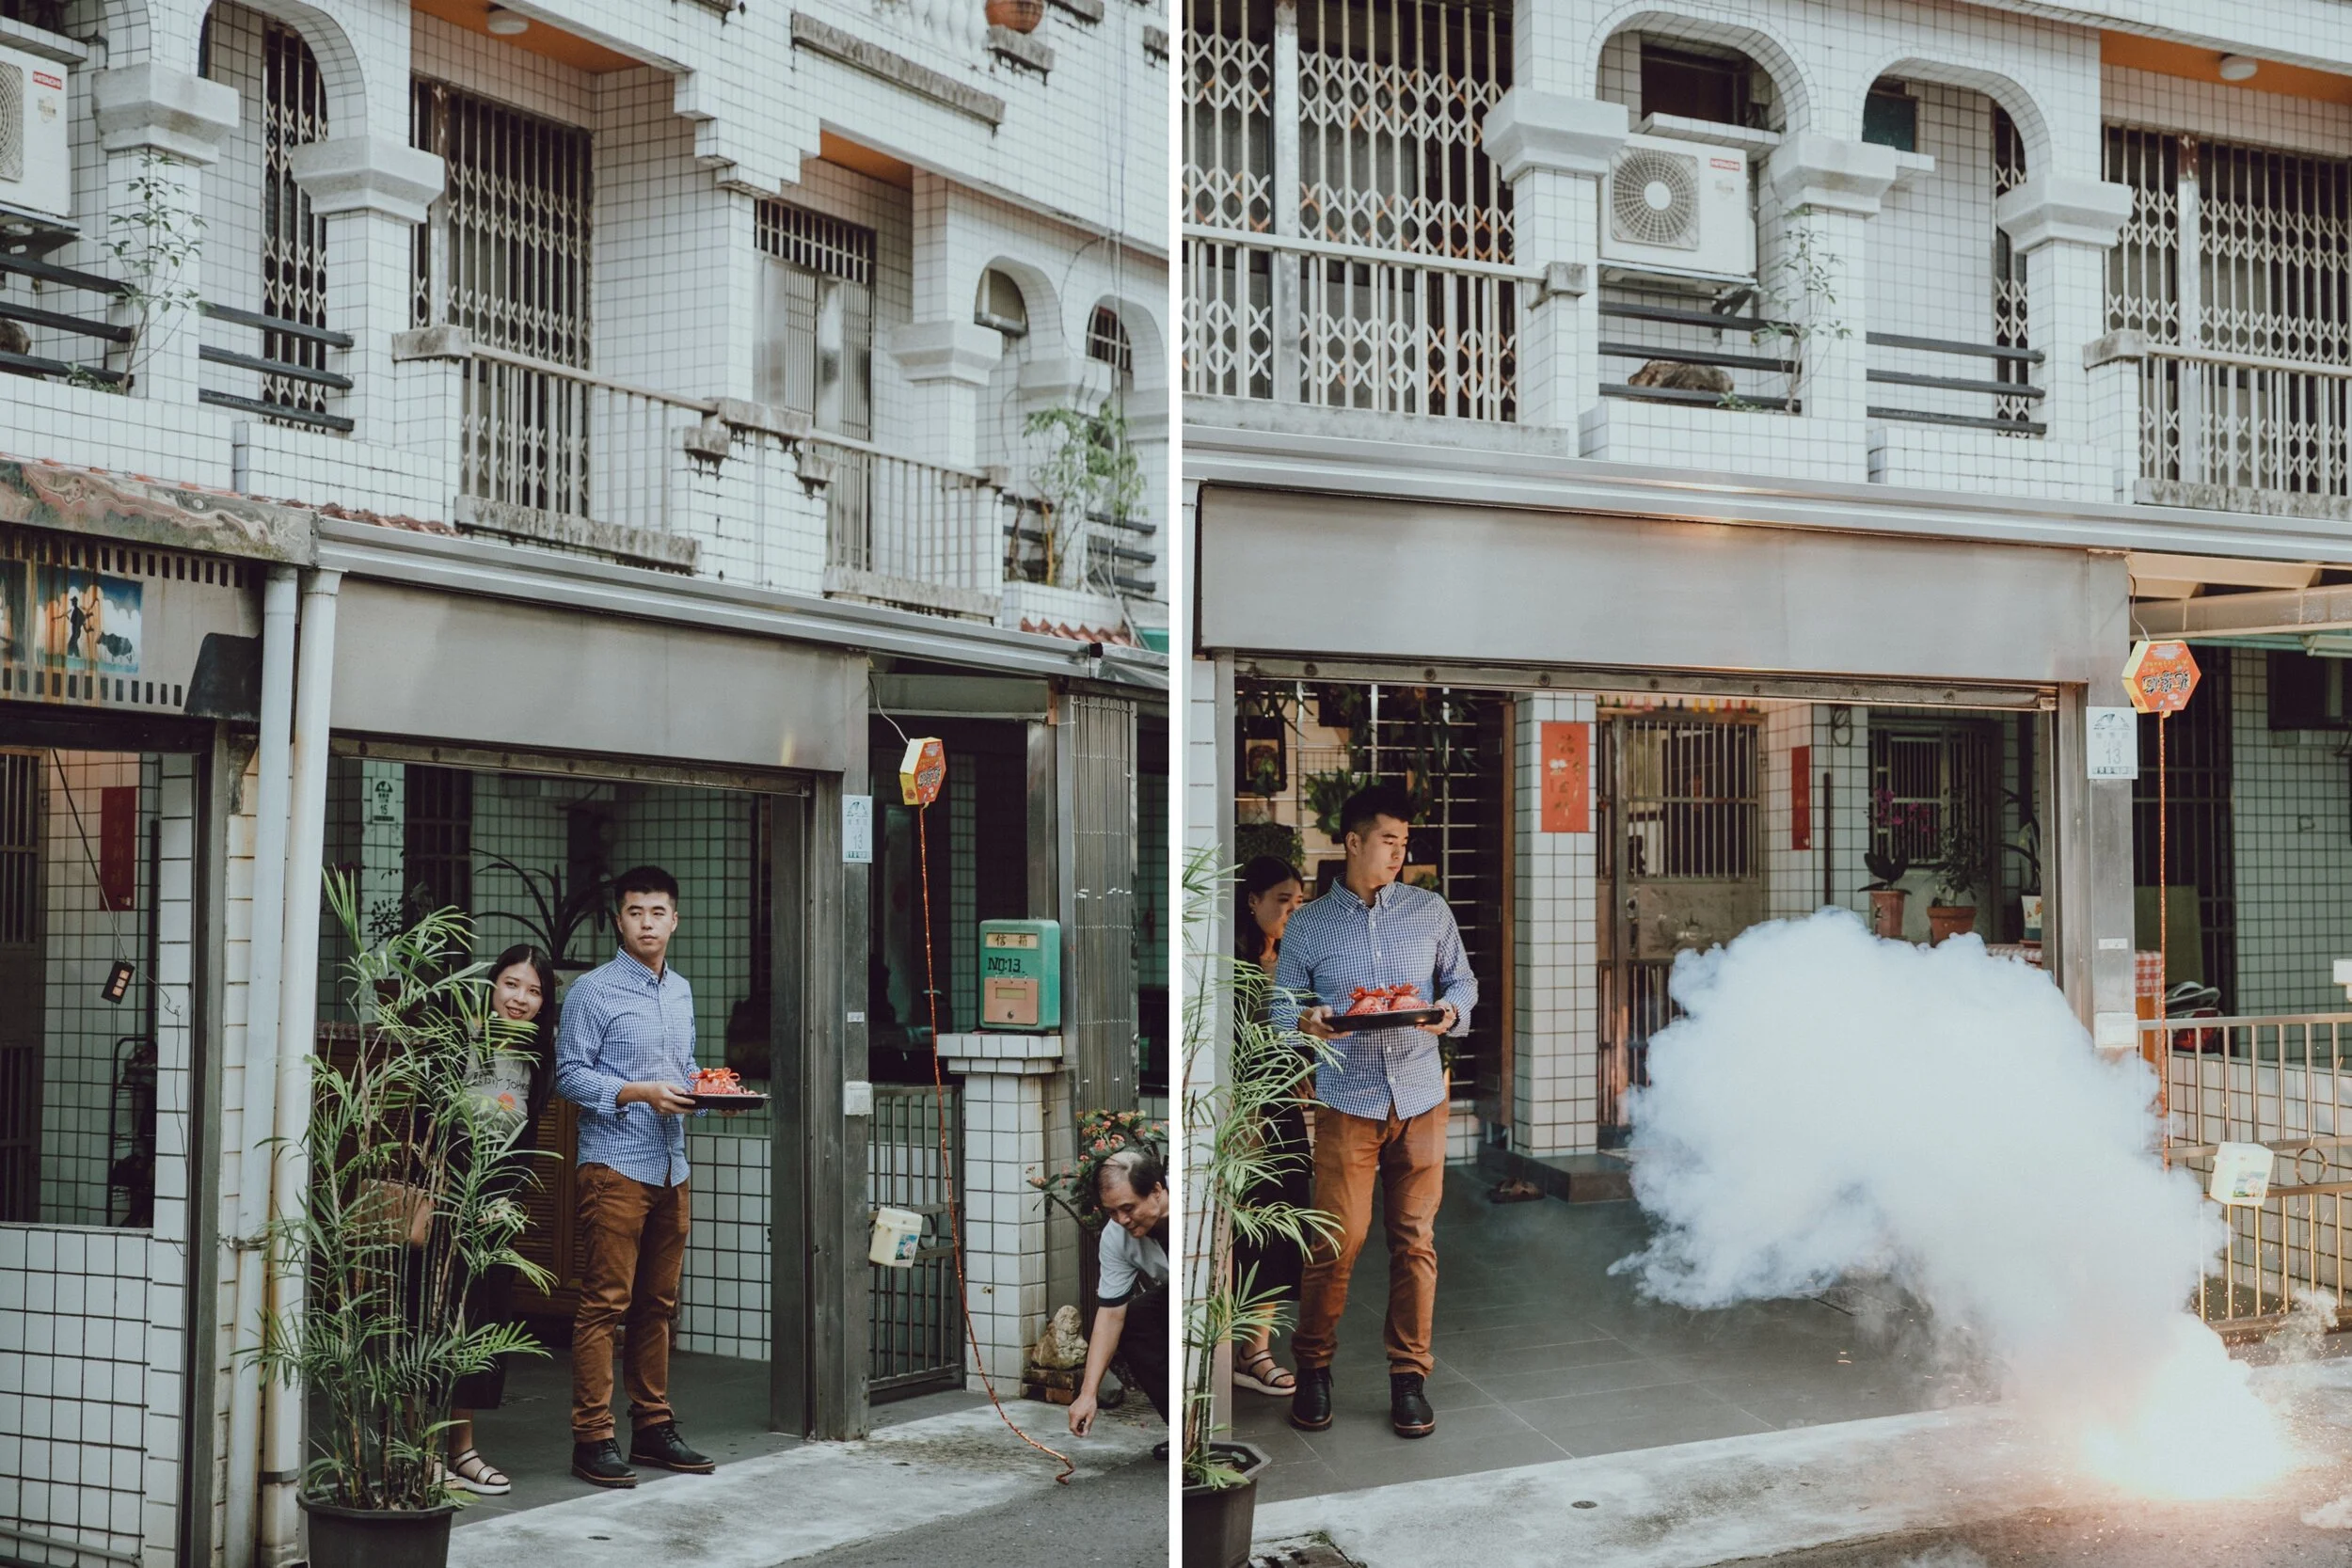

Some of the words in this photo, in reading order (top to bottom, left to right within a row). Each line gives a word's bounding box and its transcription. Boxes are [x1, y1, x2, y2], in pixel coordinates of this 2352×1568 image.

[2106, 748, 2122, 764] 13
[380, 804, 389, 815] 15
[853, 833, 864, 849] 13
